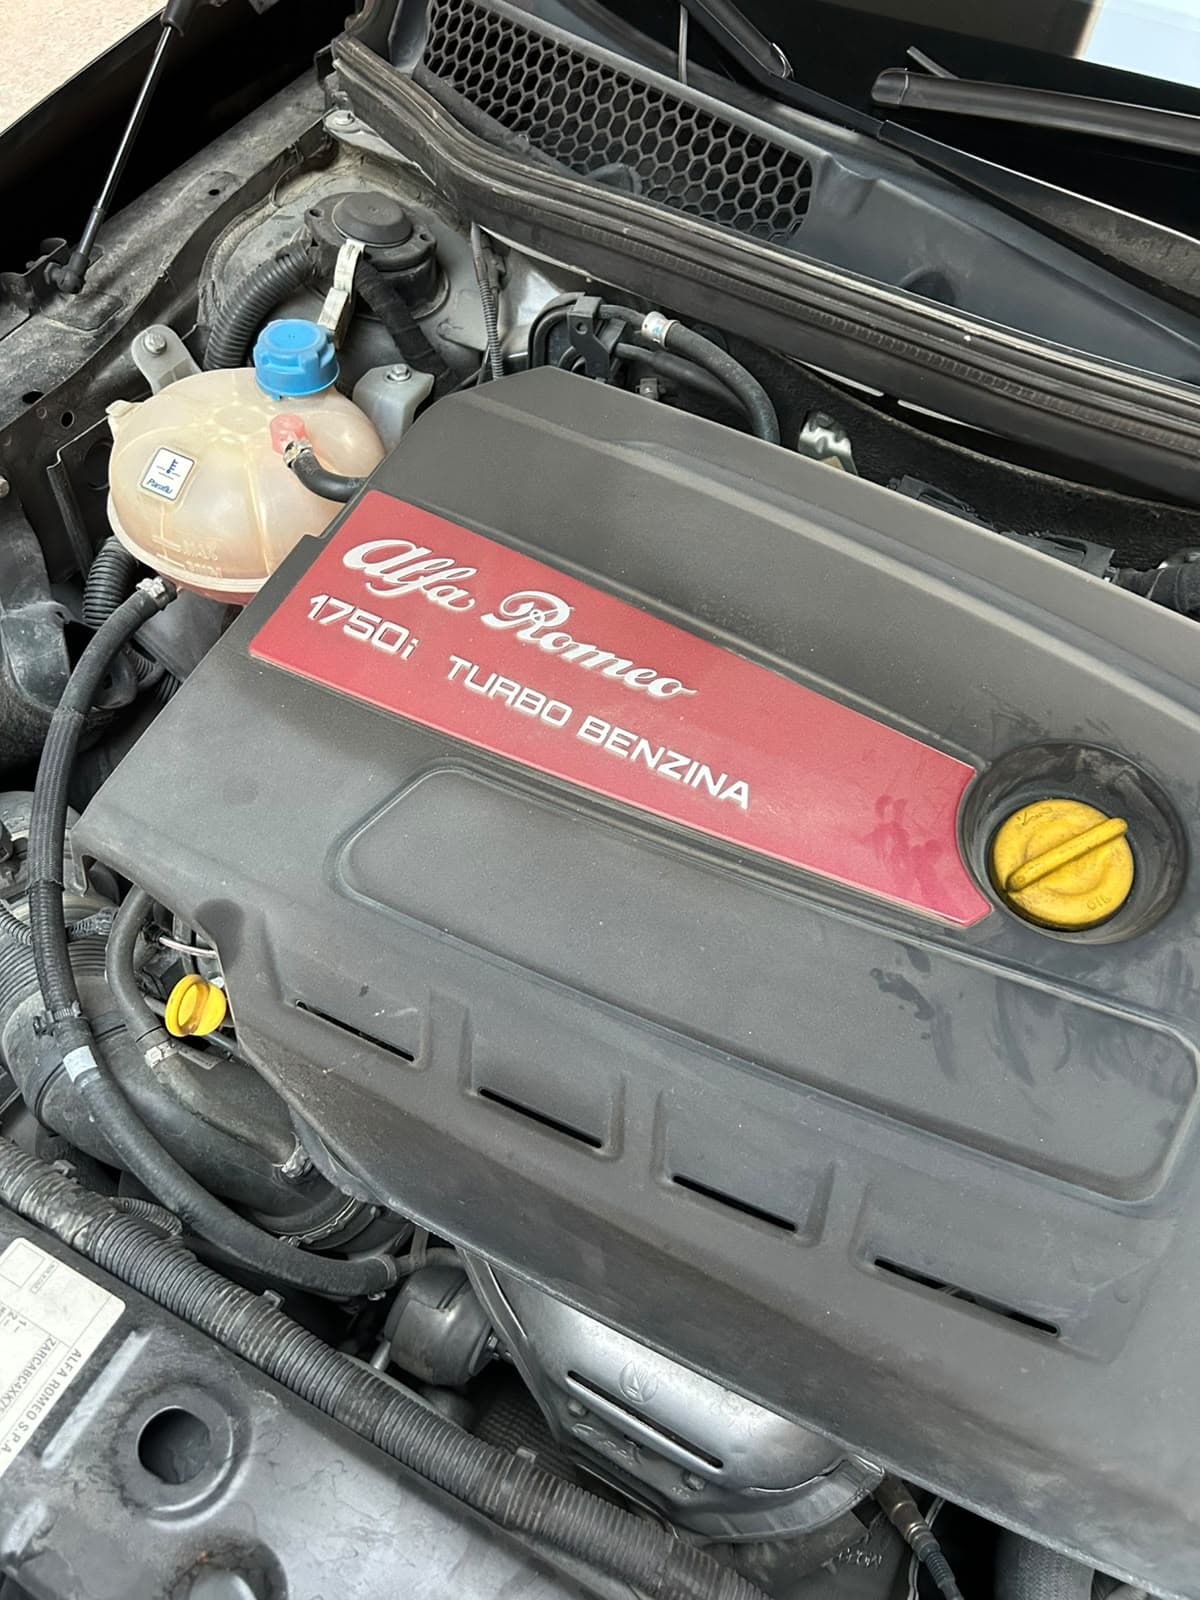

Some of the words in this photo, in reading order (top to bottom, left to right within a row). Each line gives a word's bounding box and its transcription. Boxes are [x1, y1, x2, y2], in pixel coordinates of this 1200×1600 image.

[342, 539, 478, 610] Alfa
[480, 590, 698, 697] Romeo
[307, 593, 420, 660] 1750i
[448, 654, 574, 729] TURBO
[577, 715, 752, 811] BENZINA
[56, 1348, 82, 1378] ALFA
[26, 1379, 61, 1421] ROMEO
[1, 1421, 30, 1453] S.P.A
